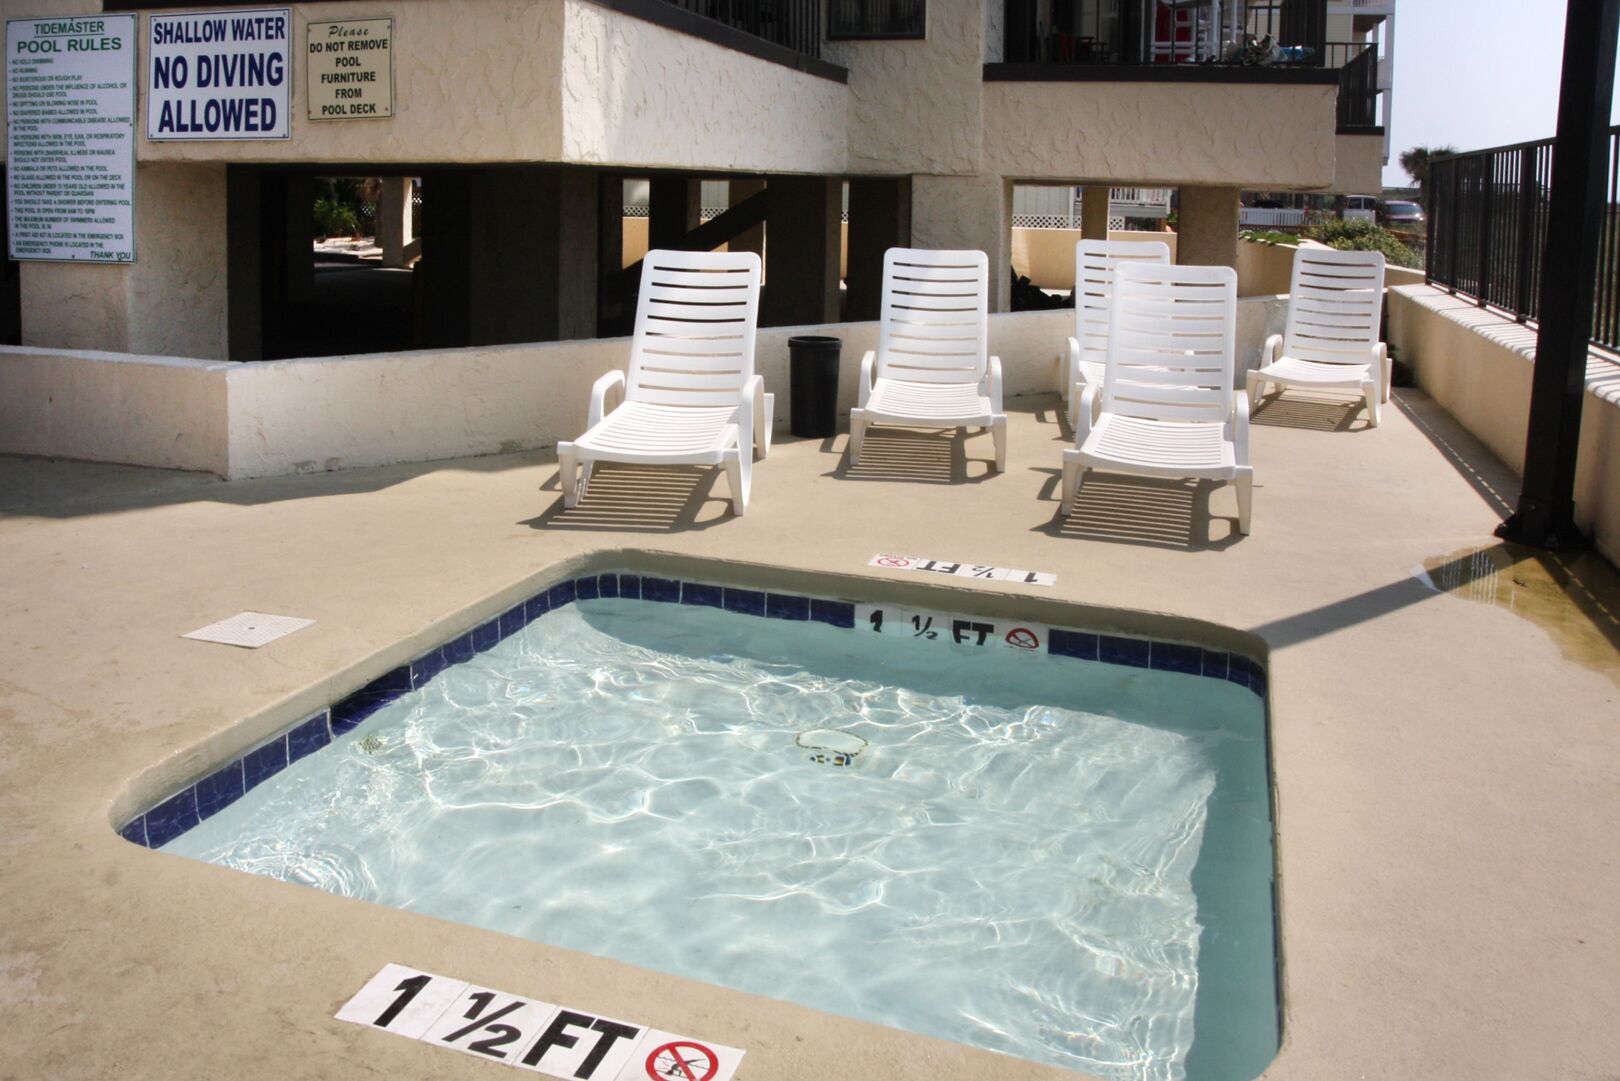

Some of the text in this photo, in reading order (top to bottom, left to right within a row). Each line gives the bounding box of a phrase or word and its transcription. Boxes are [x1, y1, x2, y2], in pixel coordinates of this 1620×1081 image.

[34, 21, 104, 34] TIDEMASTER
[154, 16, 286, 44] SHALLOW WATER
[328, 25, 368, 38] Please
[18, 38, 122, 54] POOL RULES
[310, 39, 388, 54] DO NOT REMOVE
[336, 56, 361, 68] POOL
[154, 52, 284, 89] NO DIVING
[321, 72, 376, 84] FURNITURE
[336, 88, 362, 98] FROM
[158, 98, 276, 132] ALLOWED
[322, 104, 376, 115] POOL DECK
[916, 560, 961, 574] FT
[870, 610, 884, 632] 1
[953, 620, 994, 646] FT
[372, 974, 432, 1028] 1
[521, 1009, 640, 1080] FT
